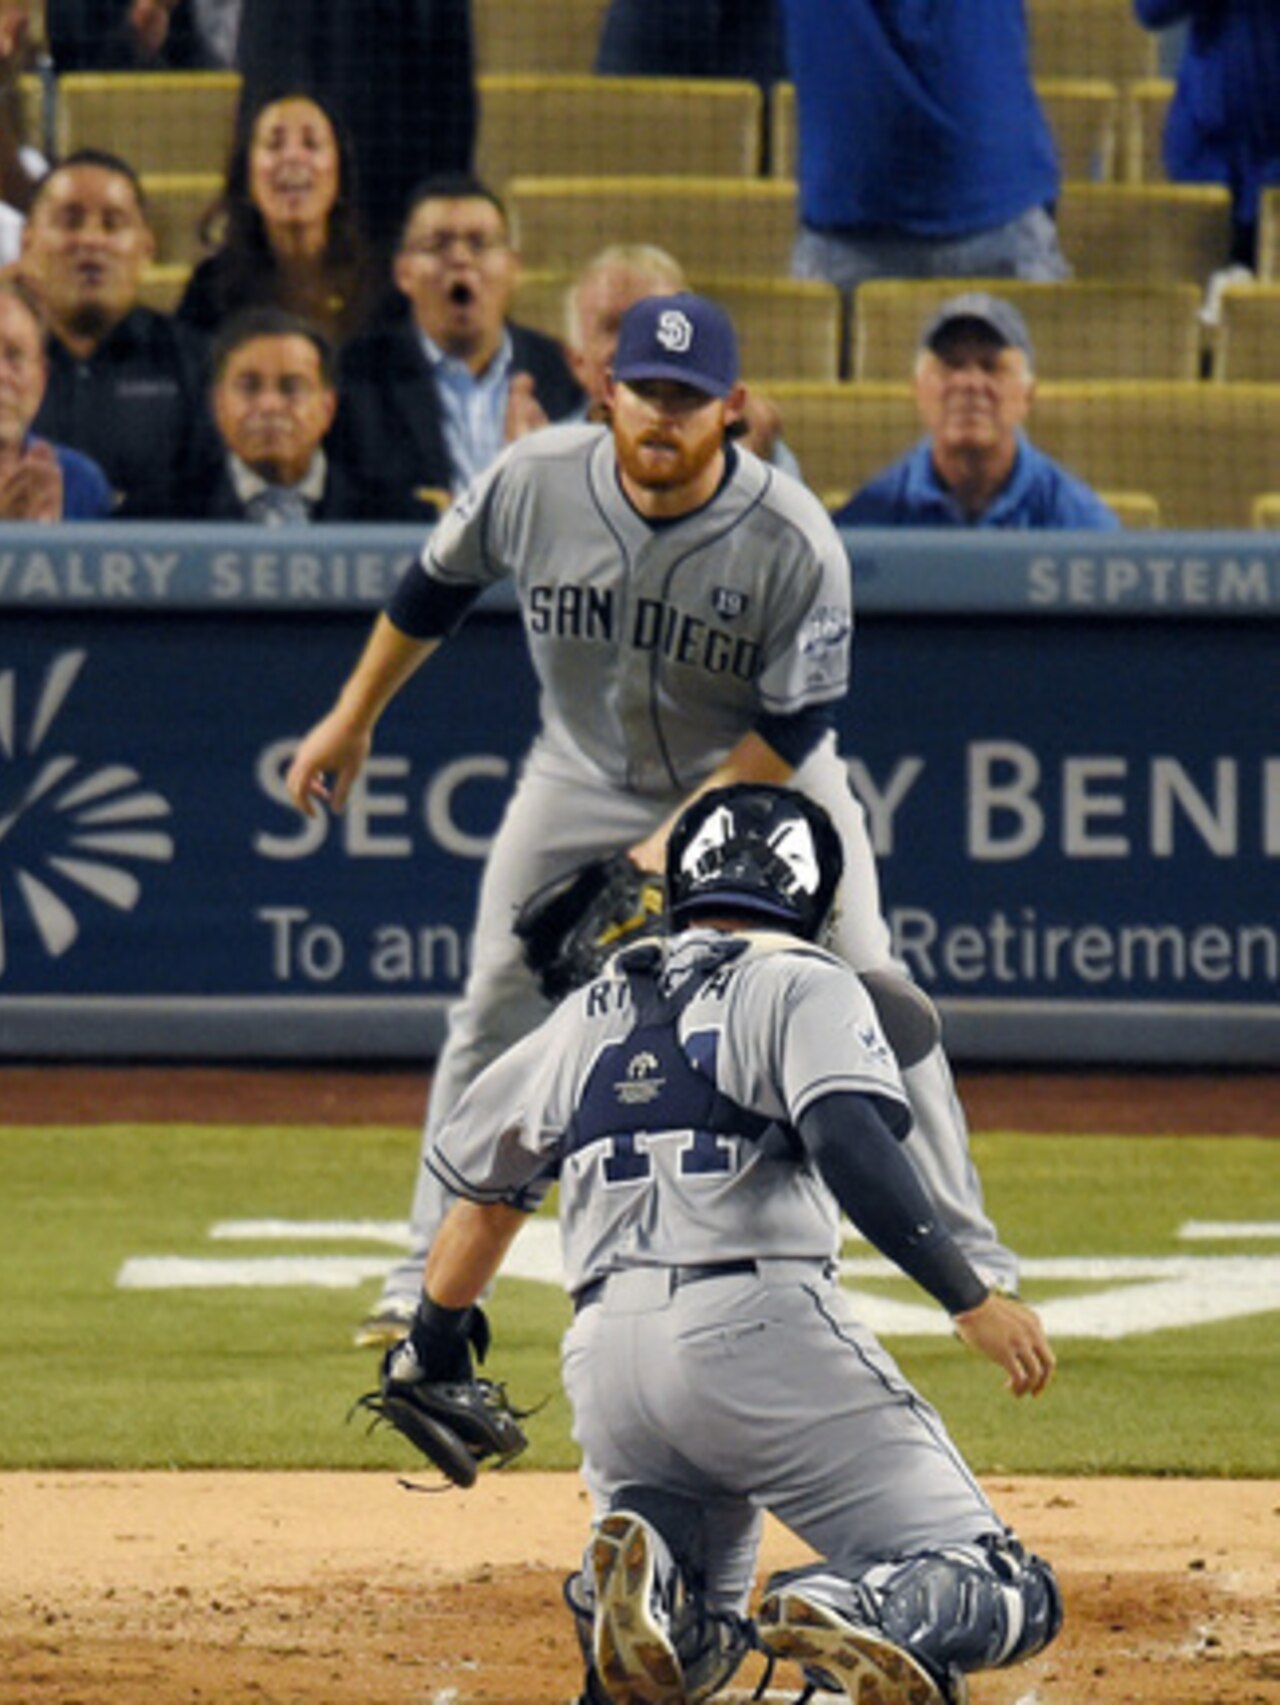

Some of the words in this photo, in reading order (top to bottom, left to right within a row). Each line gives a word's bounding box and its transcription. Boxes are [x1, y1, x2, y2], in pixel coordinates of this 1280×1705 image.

[1027, 556, 1271, 604] SEPTEM
[530, 585, 614, 641] SAN
[632, 597, 767, 683] DIEGO
[966, 739, 1280, 862] BEN
[259, 906, 344, 981] To
[372, 922, 473, 981] an
